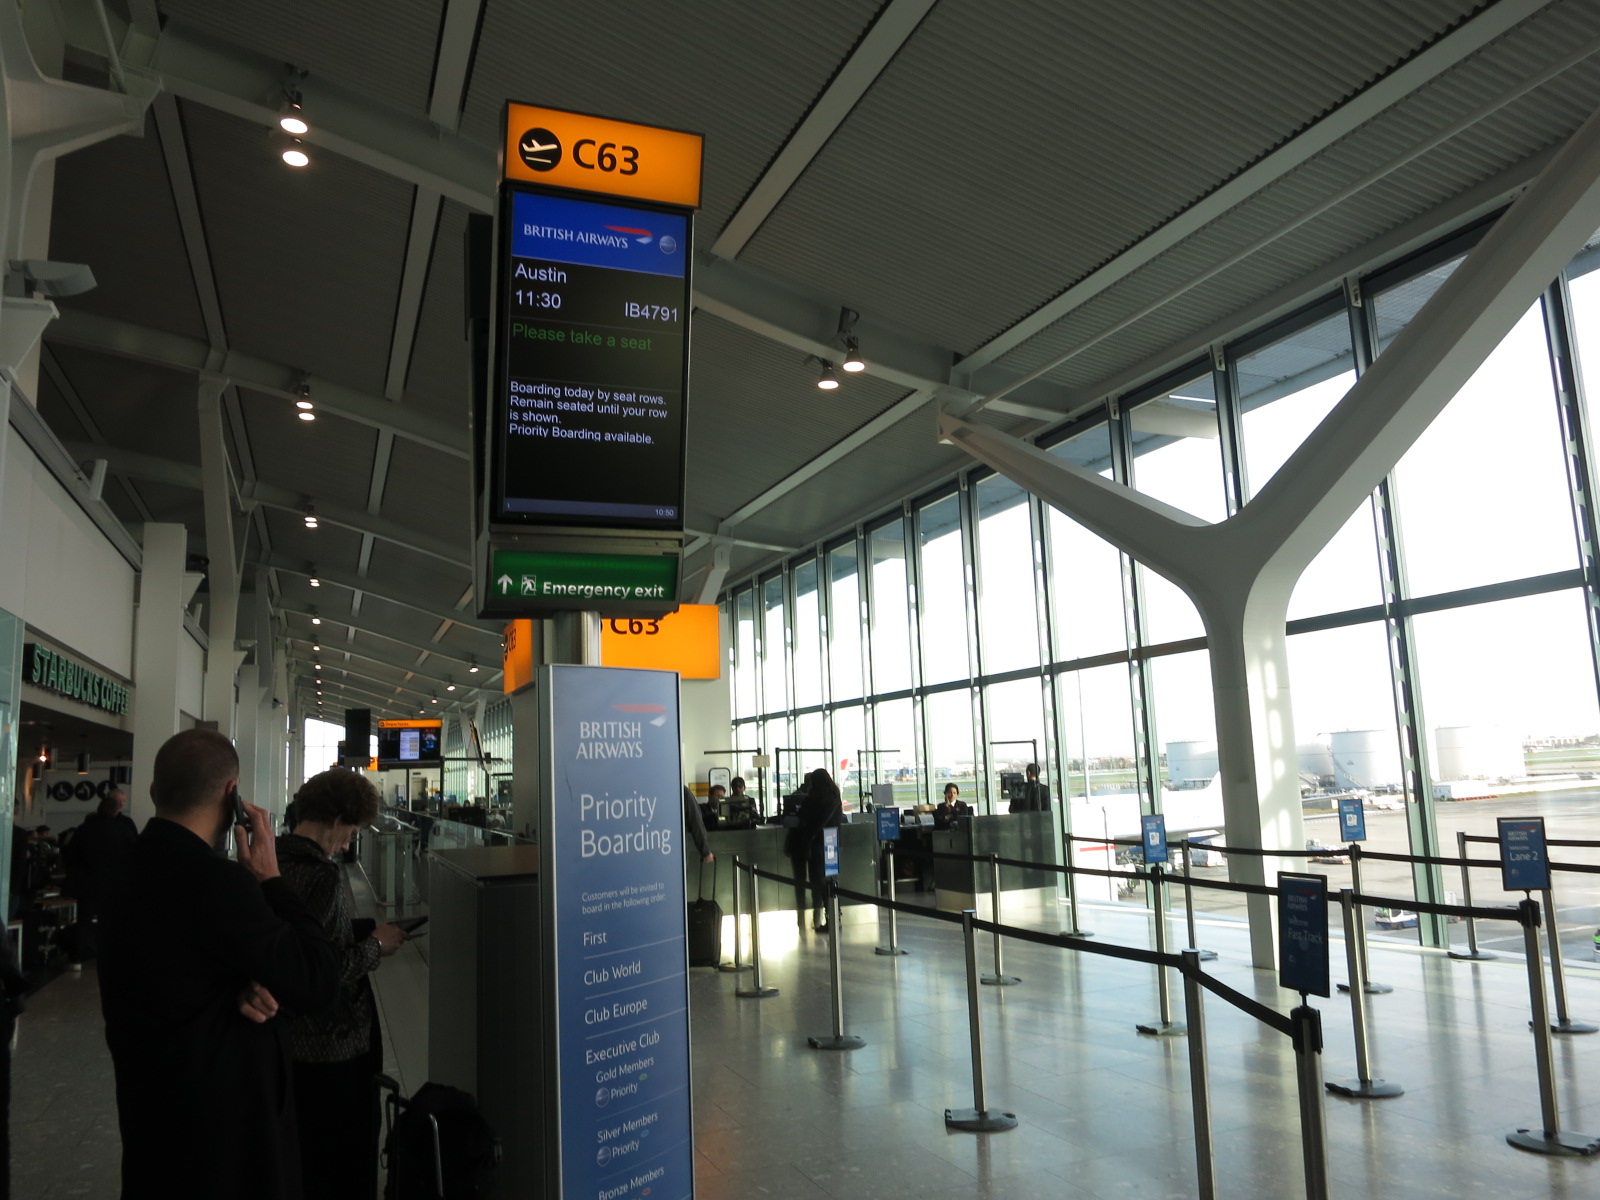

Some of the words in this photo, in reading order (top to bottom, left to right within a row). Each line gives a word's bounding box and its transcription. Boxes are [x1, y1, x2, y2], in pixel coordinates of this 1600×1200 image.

[572, 139, 639, 175] C63
[524, 224, 574, 241] BRITISH
[576, 231, 628, 248] AIRWAYS
[515, 263, 567, 284] Austin
[515, 290, 561, 309] 11:30
[625, 302, 678, 322] IB4791
[512, 323, 565, 342] Please
[570, 330, 602, 345] take
[607, 336, 616, 347] a
[621, 337, 652, 350] seat
[510, 381, 561, 398] Boarding
[564, 386, 594, 400] today
[597, 389, 610, 402] by
[613, 392, 636, 403] seat
[639, 395, 666, 405] rows.
[509, 409, 519, 420] is
[522, 411, 561, 424] shown.
[510, 396, 553, 409] Remain
[557, 399, 593, 413] seated
[597, 403, 619, 415] until
[623, 406, 645, 418] your
[648, 409, 668, 419] row
[509, 423, 549, 437] Priority
[552, 426, 601, 442] Boarding
[604, 431, 655, 444] available.
[656, 508, 674, 516] 10:50
[542, 581, 631, 600] Emergency
[634, 584, 665, 598] exit
[610, 619, 660, 635] C63
[32, 642, 100, 706] STARBUCKS
[101, 677, 129, 716] COFFEE
[580, 721, 641, 739] BRITISH
[576, 741, 643, 759] AIRWAYS
[580, 791, 657, 822] Priority
[581, 824, 671, 858] Boarding
[1510, 852, 1530, 861] Lane
[1532, 851, 1538, 860] 2
[582, 890, 618, 902] Customers
[619, 887, 629, 896] will
[630, 886, 638, 894] be
[639, 883, 658, 893] invited
[658, 882, 664, 890] to
[582, 903, 602, 914] board
[604, 902, 610, 910] in
[611, 900, 622, 910] the
[623, 897, 649, 908] following
[583, 932, 607, 946] First
[584, 968, 609, 985] Club
[612, 960, 641, 979] World
[585, 1007, 609, 1024] Club
[613, 999, 648, 1018] Europe
[585, 1040, 636, 1064] Executive
[639, 1032, 660, 1048] Club
[596, 1068, 617, 1083] Gold
[619, 1056, 655, 1075] Members
[610, 1083, 638, 1099] Priority
[597, 1126, 621, 1143] Silver
[623, 1112, 658, 1132] Members
[612, 1140, 640, 1158] Priority
[598, 1184, 629, 1200] Bronze
[630, 1166, 664, 1190] Members
